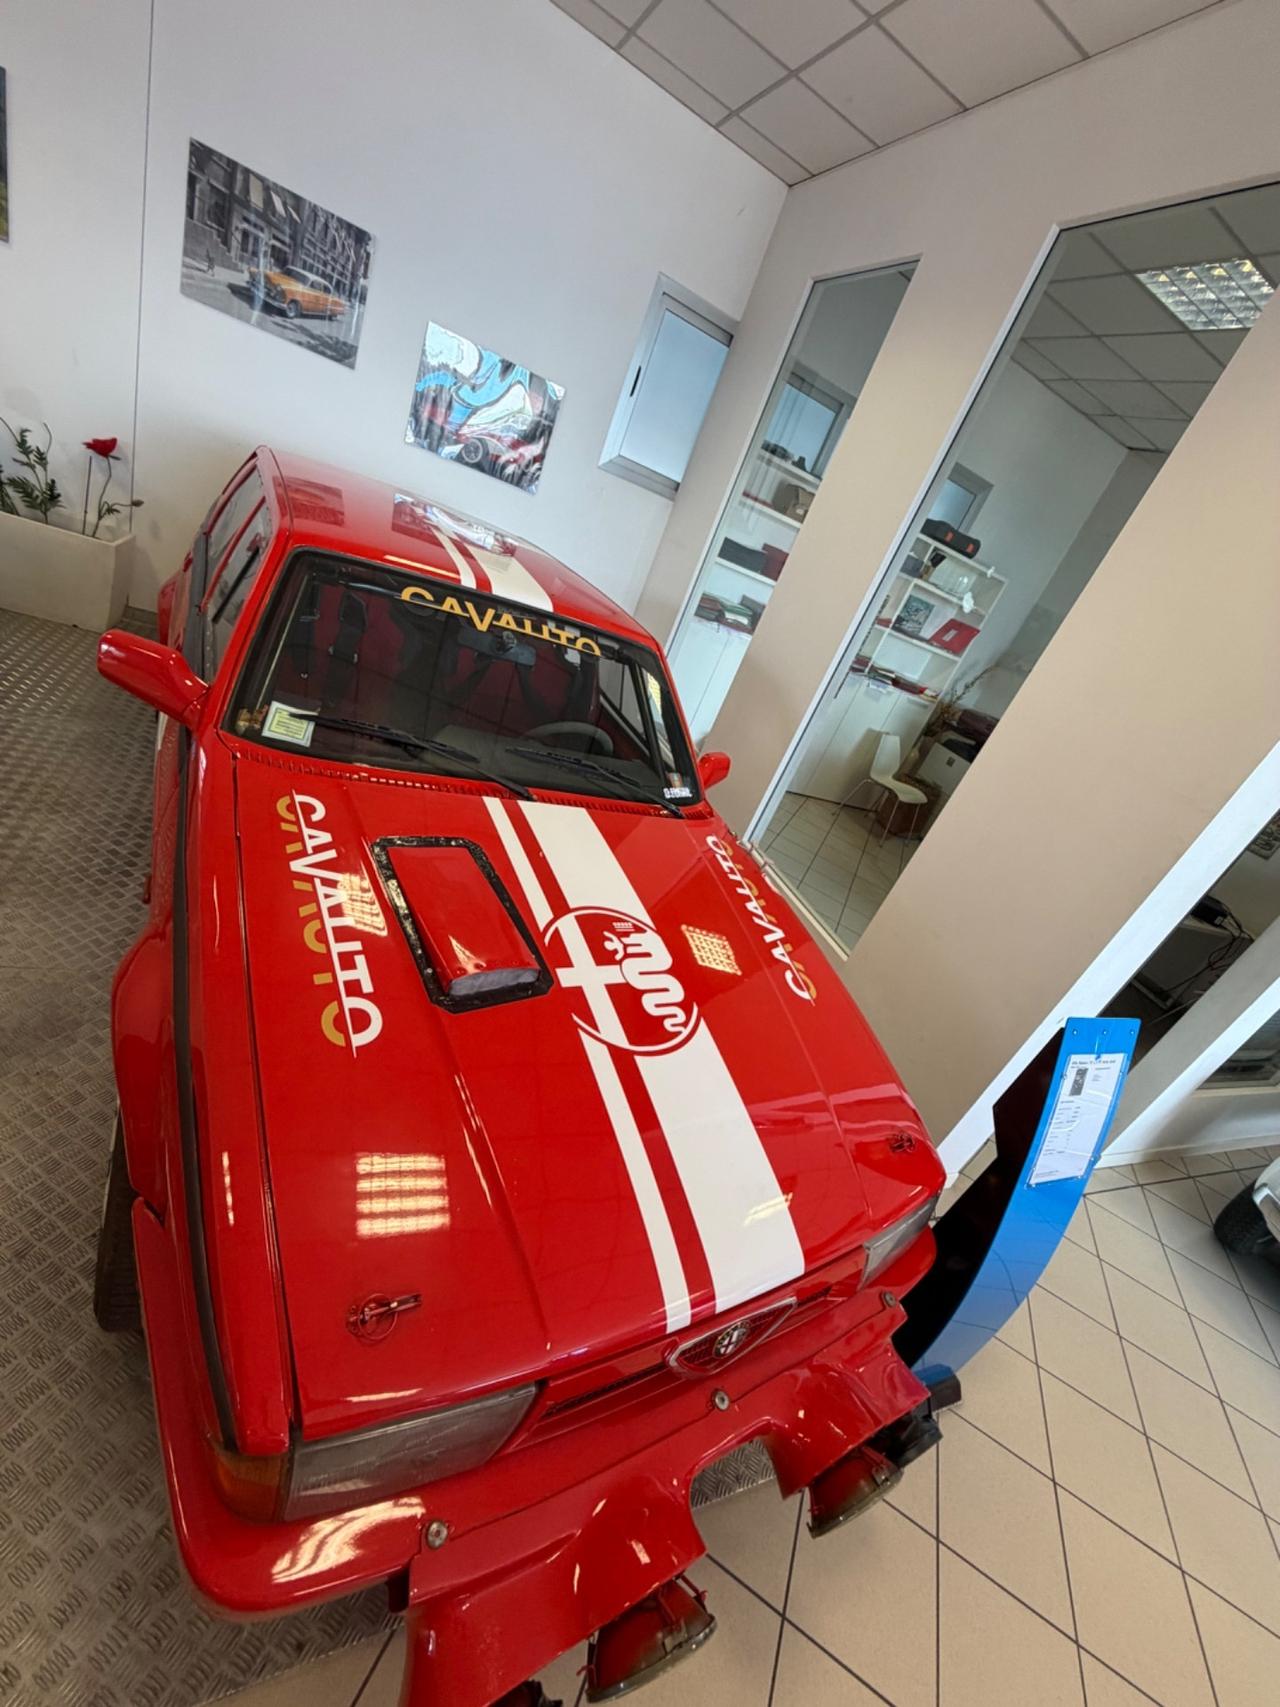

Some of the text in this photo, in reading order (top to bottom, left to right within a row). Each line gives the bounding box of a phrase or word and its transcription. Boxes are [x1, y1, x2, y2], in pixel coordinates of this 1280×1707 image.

[396, 586, 602, 658] CAVAUTO
[276, 789, 384, 1058] CAVAUTO
[706, 835, 816, 1006] CAVAUTO
